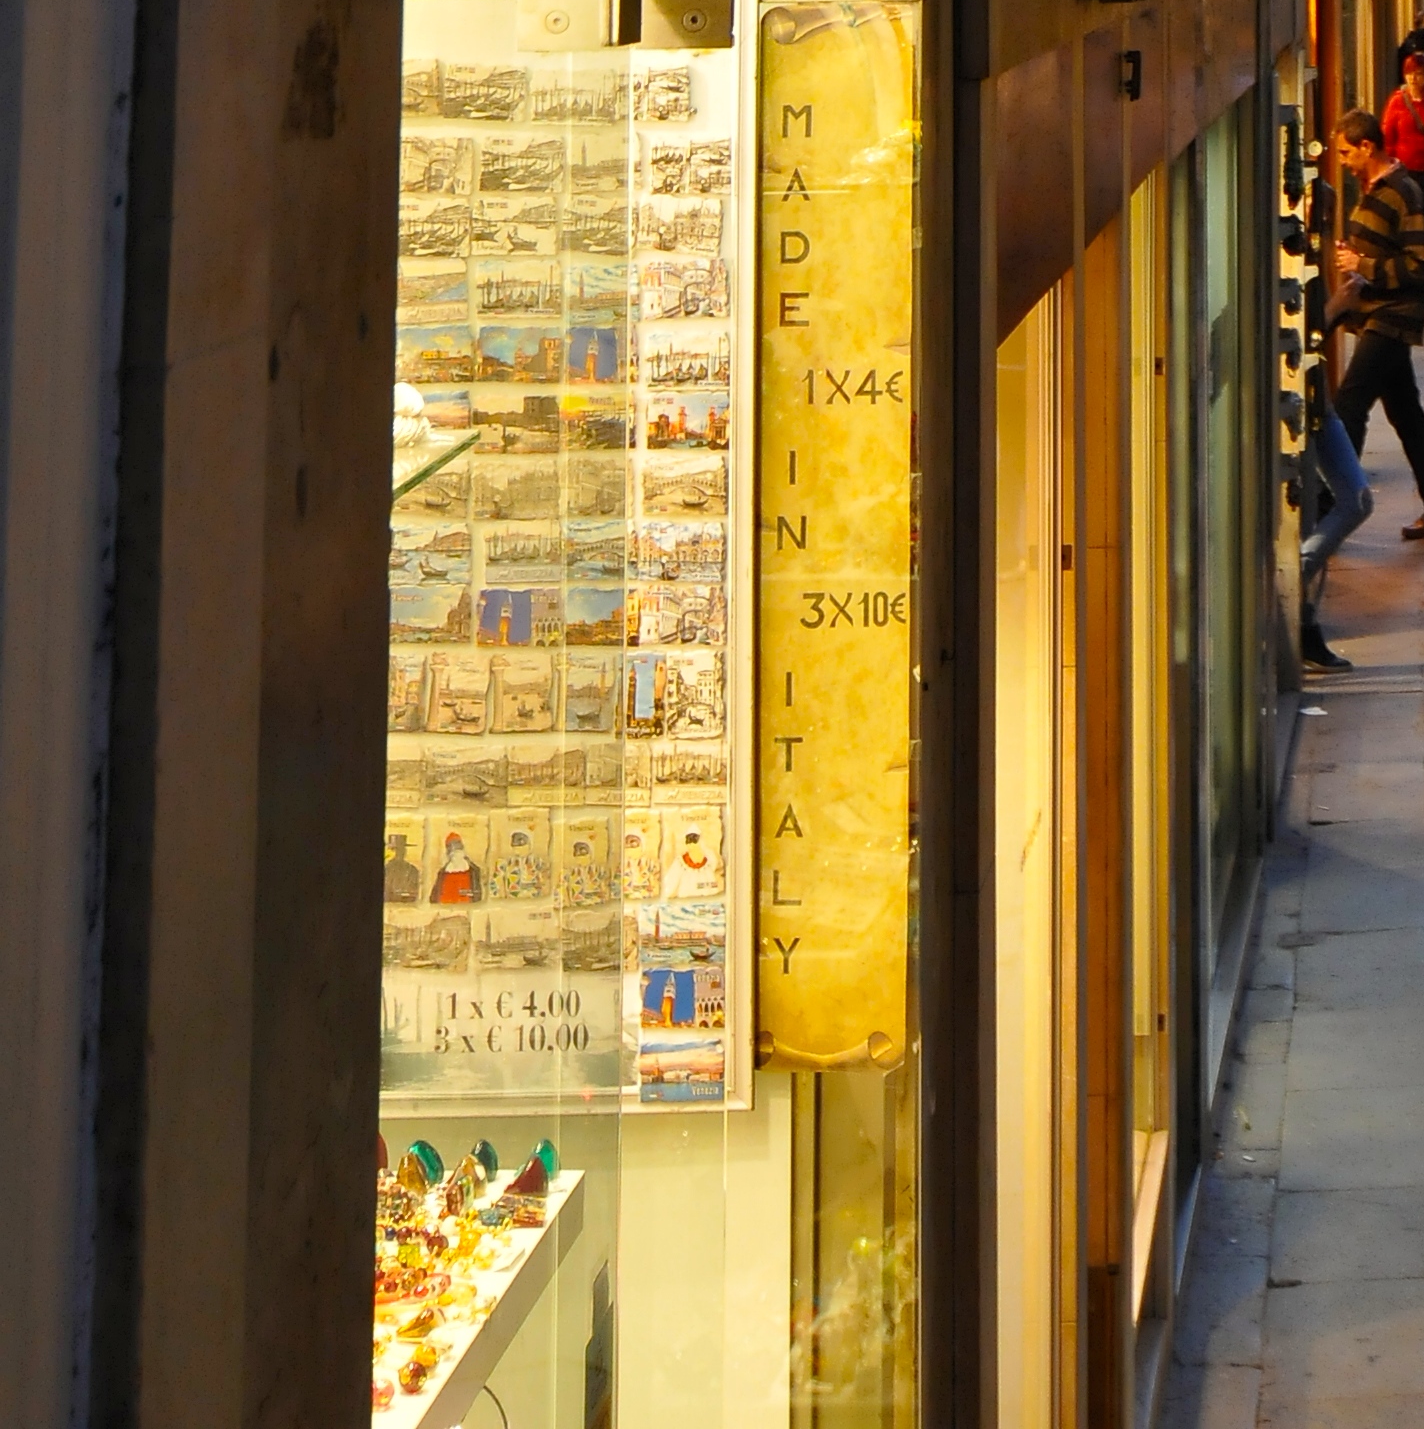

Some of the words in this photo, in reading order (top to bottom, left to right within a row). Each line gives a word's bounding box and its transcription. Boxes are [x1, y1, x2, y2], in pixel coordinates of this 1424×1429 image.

[779, 104, 815, 328] MADE
[801, 368, 905, 406] 1X4€
[776, 450, 809, 552] IN
[799, 590, 908, 629] 3X10€
[772, 671, 805, 975] ITALY
[446, 992, 457, 1020] 1
[496, 990, 513, 1019] €
[435, 1025, 450, 1055] 3
[487, 1025, 502, 1053] €
[691, 1086, 720, 1096] Venezia
